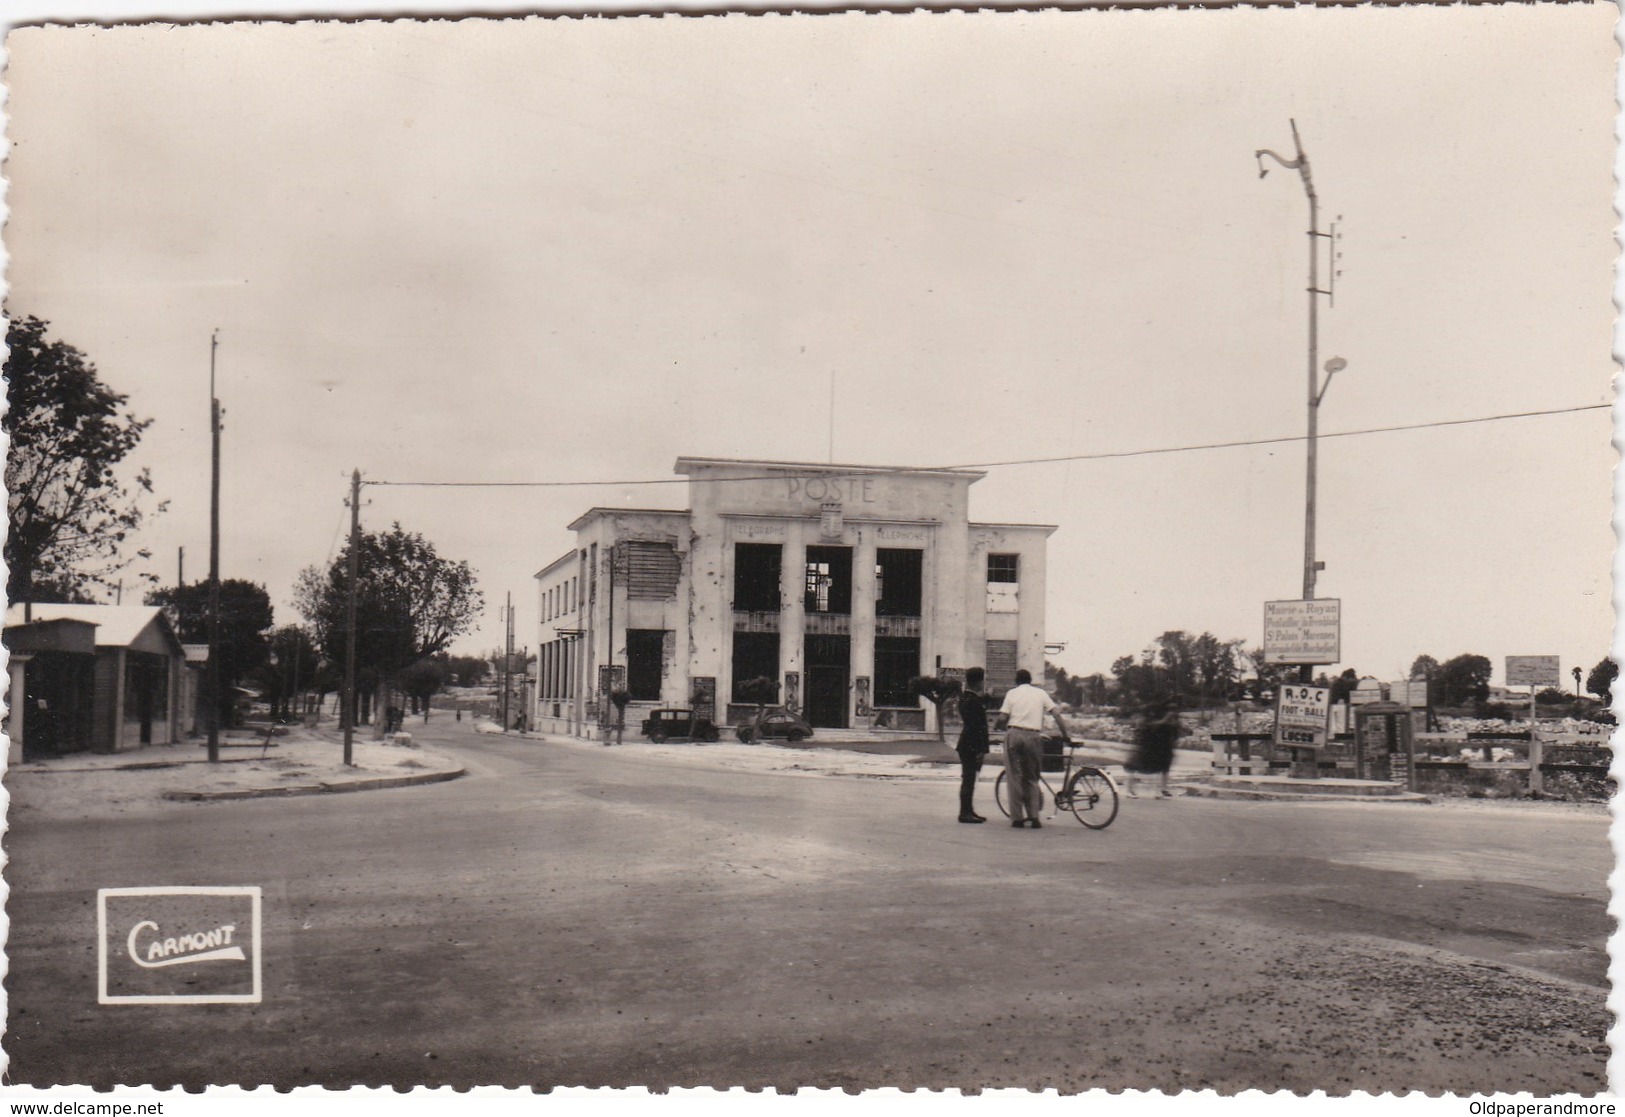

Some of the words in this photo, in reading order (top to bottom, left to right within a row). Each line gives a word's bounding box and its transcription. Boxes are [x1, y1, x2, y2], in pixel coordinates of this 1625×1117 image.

[787, 476, 875, 503] POSTE
[1306, 602, 1337, 616] Royan
[1275, 629, 1299, 642] Palais
